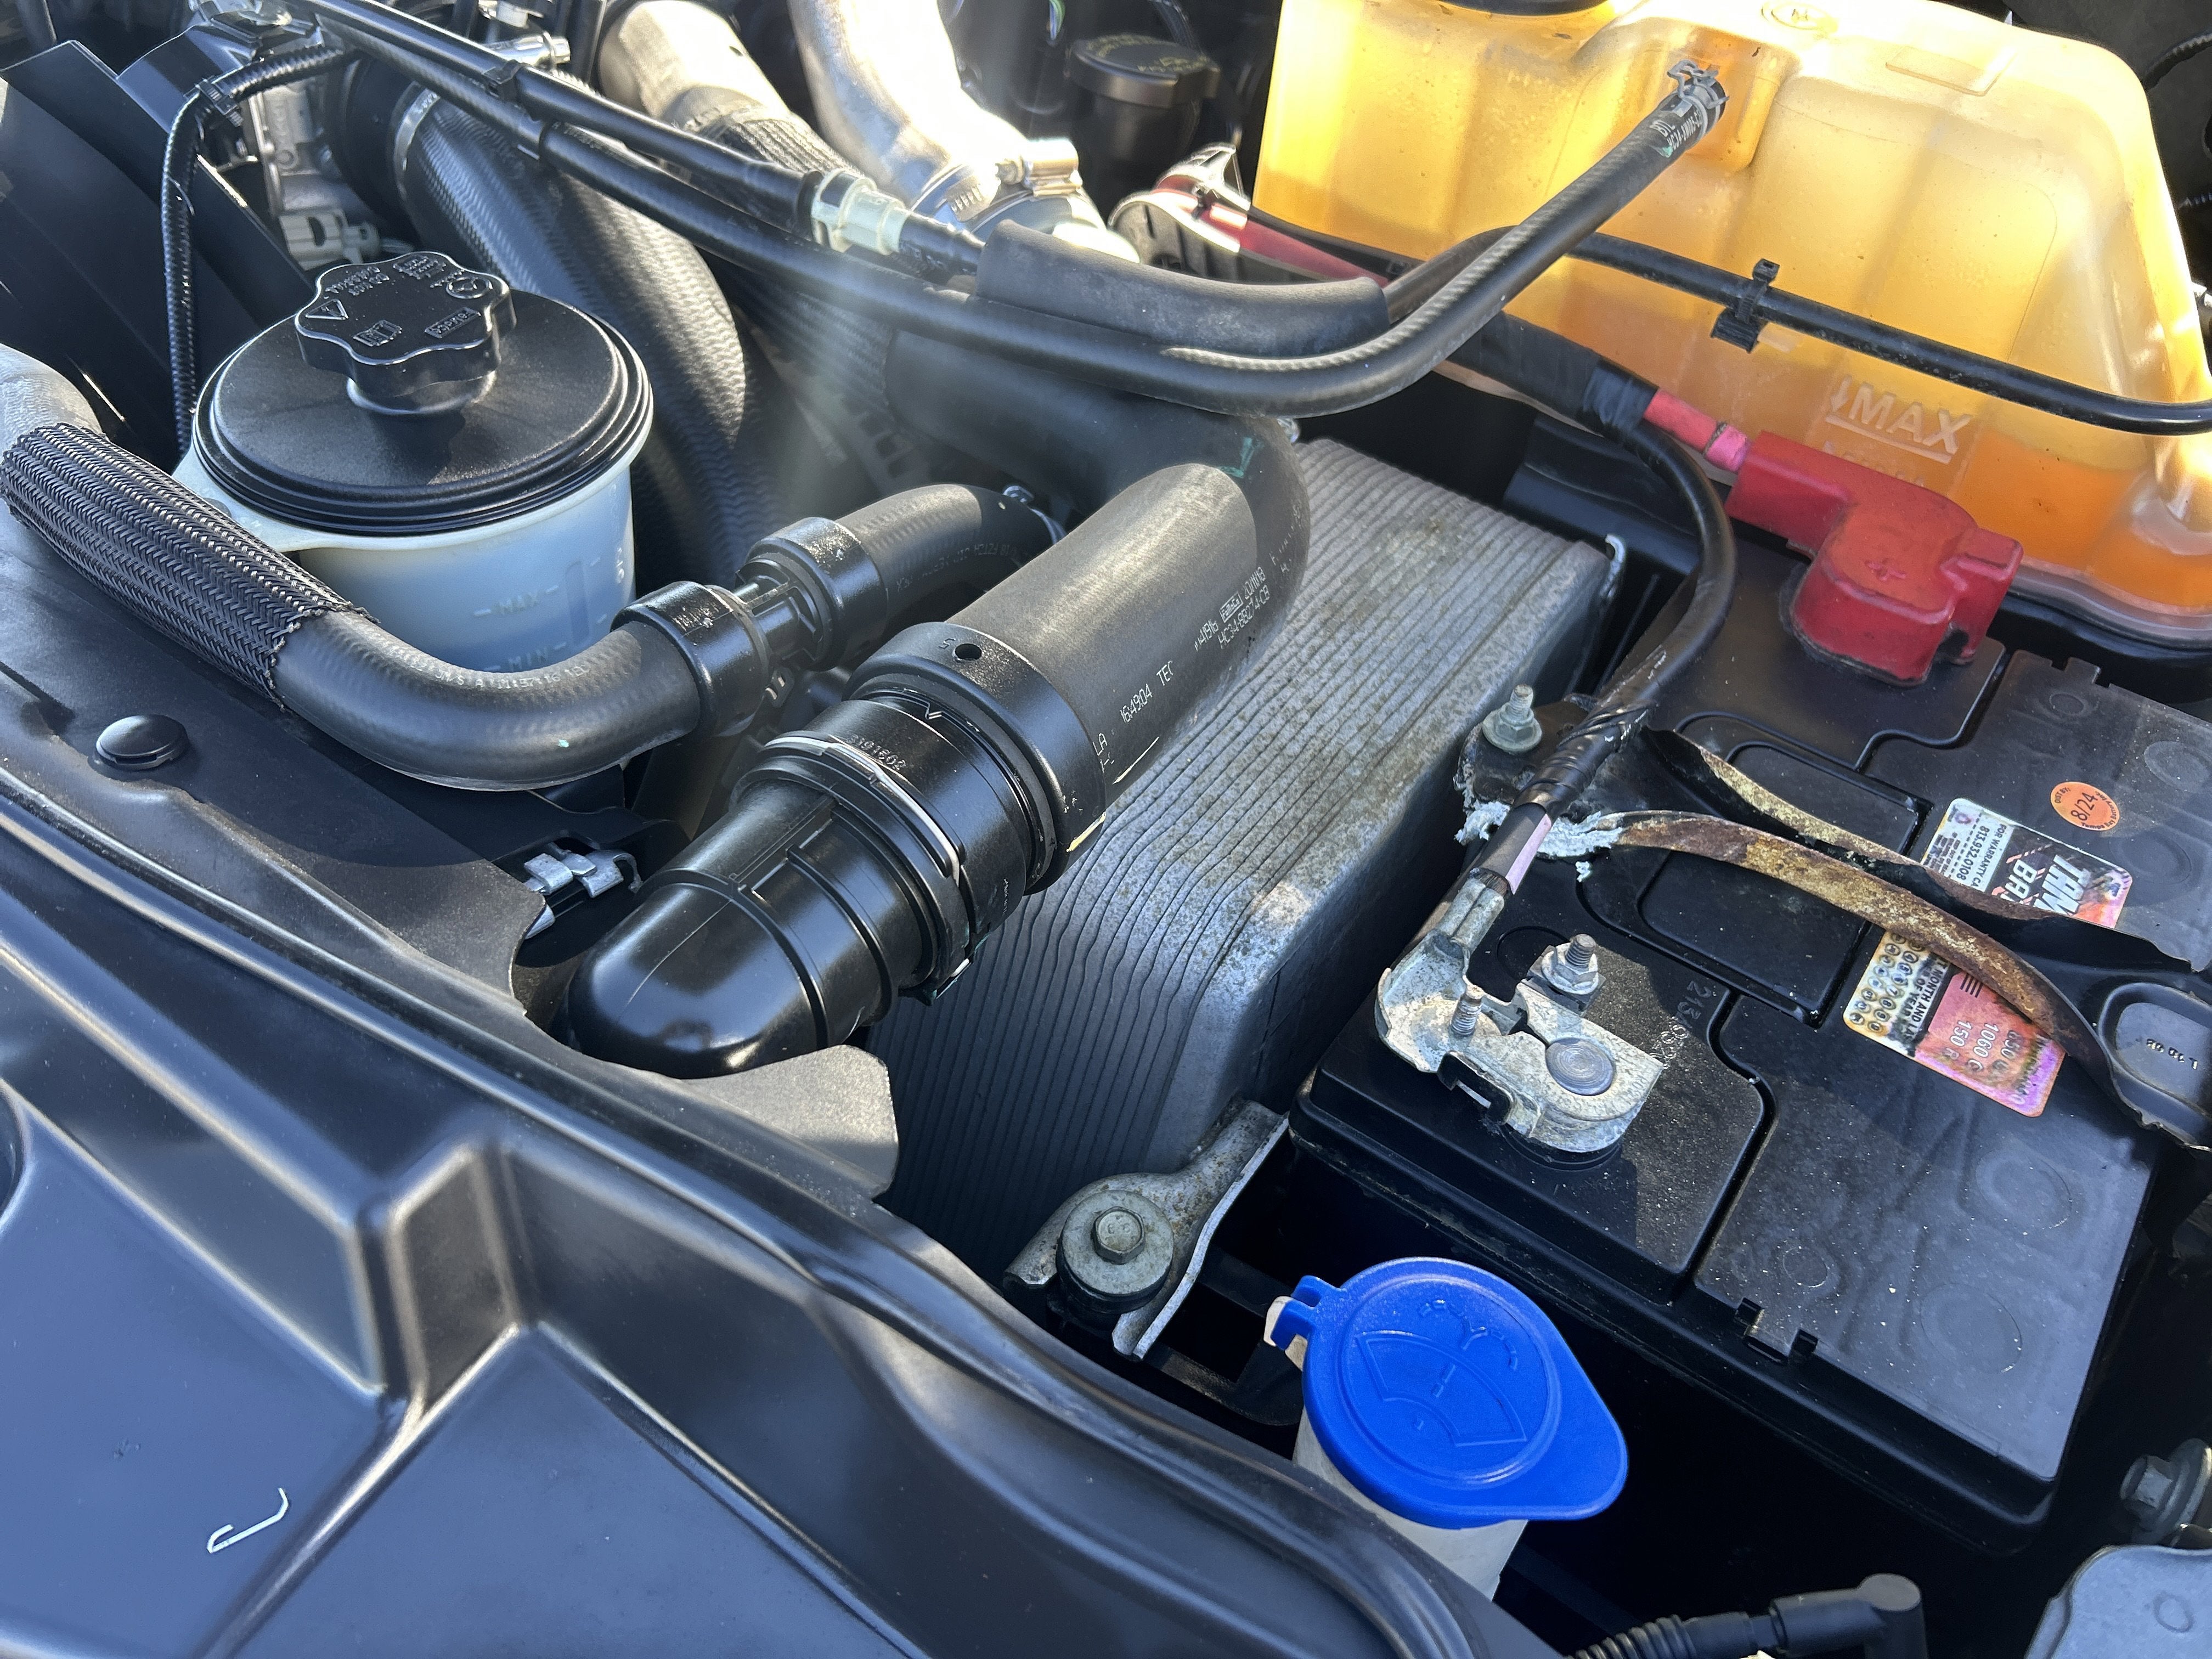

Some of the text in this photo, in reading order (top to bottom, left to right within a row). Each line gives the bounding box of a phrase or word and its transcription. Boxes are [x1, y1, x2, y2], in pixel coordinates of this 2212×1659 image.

[1849, 383, 1971, 454] MAX
[2070, 792, 2097, 821] 8/24
[1997, 824, 2007, 838] FOR
[1956, 826, 1990, 880] 813.932.0108
[1976, 838, 2000, 877] WARRANTY
[1921, 969, 1943, 1002] MONTH
[1912, 1002, 1926, 1022] AND
[1950, 1020, 1972, 1047] 150
[1973, 1023, 1997, 1058] 1060
